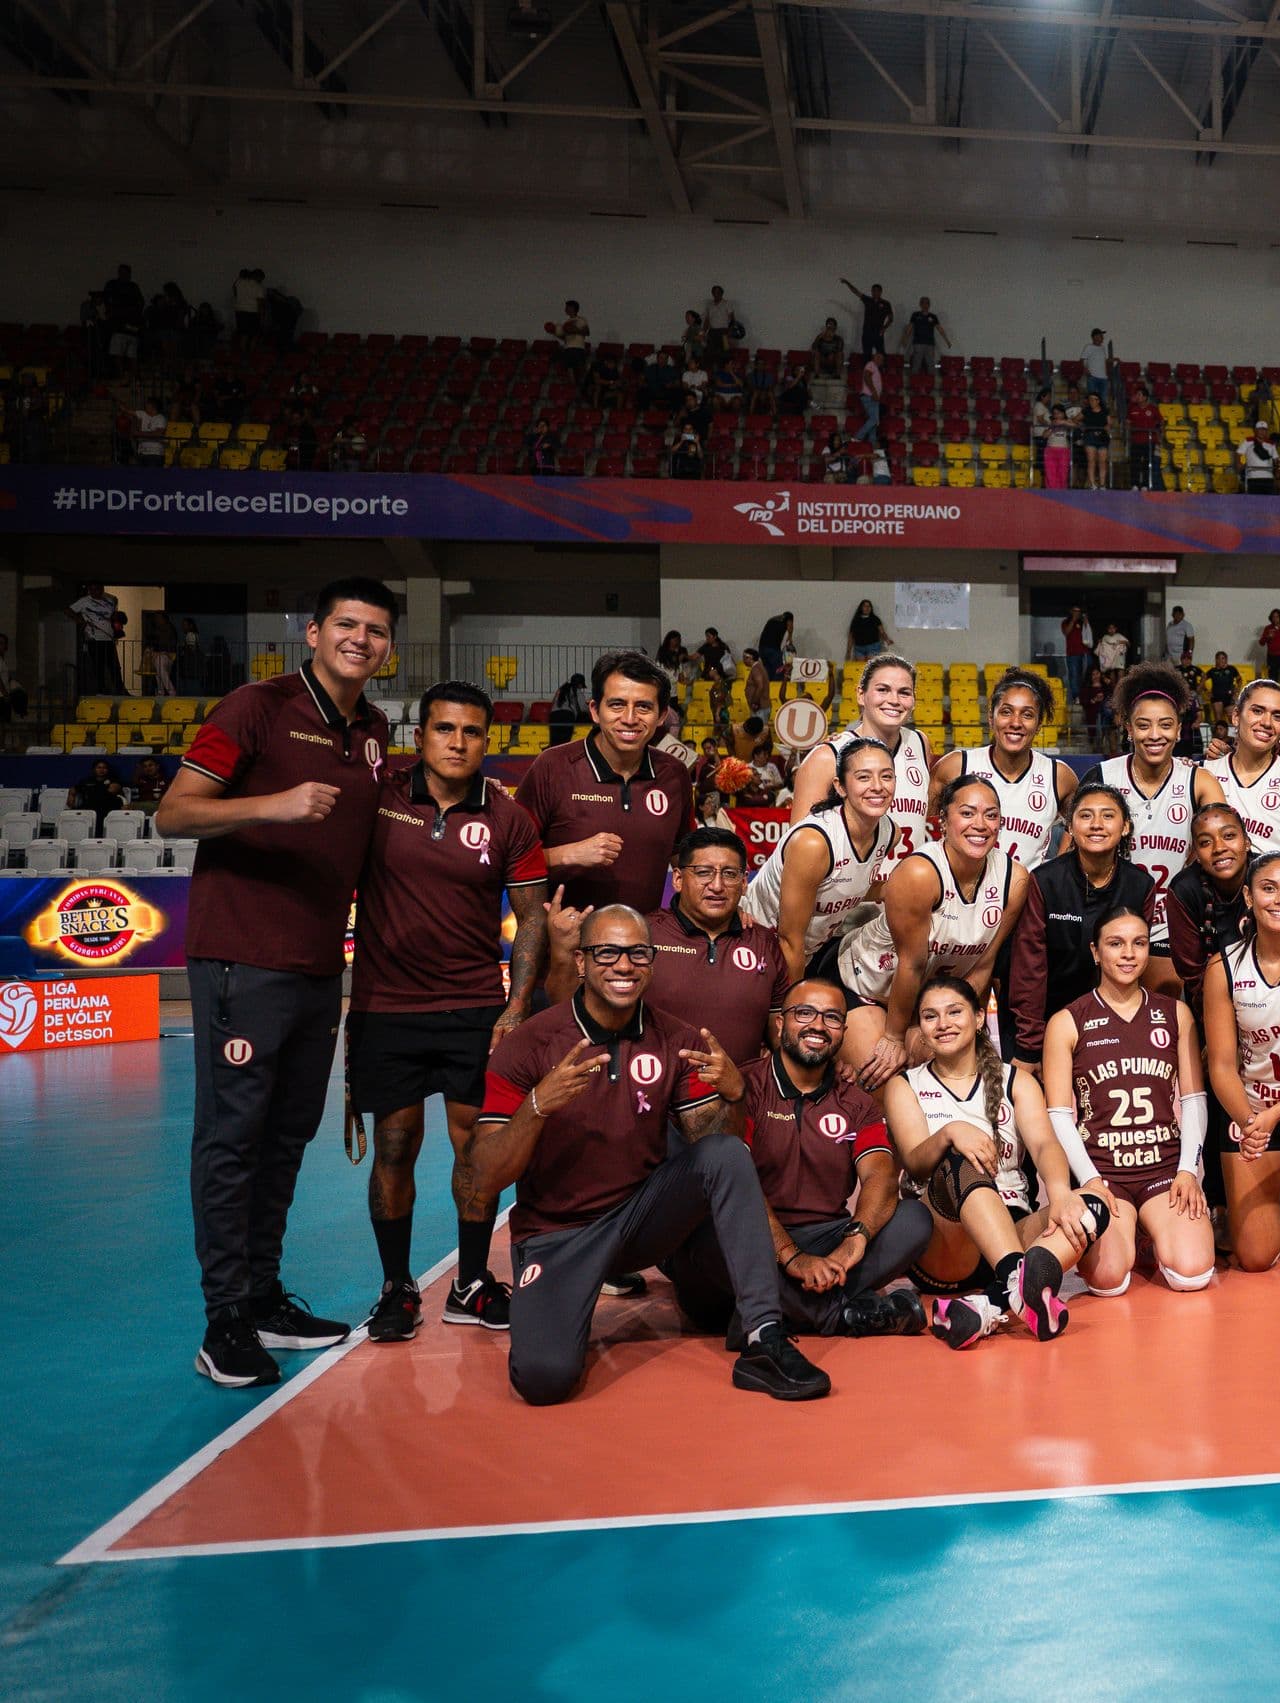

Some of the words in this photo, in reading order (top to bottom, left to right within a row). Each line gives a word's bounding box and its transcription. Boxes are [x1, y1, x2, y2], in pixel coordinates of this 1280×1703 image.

[53, 487, 409, 521] #IPDFortaleceElDeporte
[797, 502, 881, 518] INSTITUTO
[884, 504, 961, 520] PERUANO
[798, 519, 828, 533] DEL
[831, 520, 905, 535] DEPORTE
[786, 708, 818, 742] U
[289, 730, 333, 746] marathon
[571, 793, 613, 803] marathon
[377, 807, 425, 827] marathon
[1141, 835, 1187, 854] PUMAS
[1049, 912, 1083, 923] marathon
[44, 983, 77, 996] LIGA
[1234, 981, 1256, 989] MTD
[44, 995, 110, 1011] PERUANA
[1236, 1000, 1267, 1008] marathon
[44, 1014, 64, 1027] DE
[66, 1010, 112, 1025] VÓLEY
[1083, 1017, 1109, 1030] MTD
[44, 1027, 113, 1044] betsson
[1086, 1038, 1120, 1048] marathon
[1088, 1060, 1118, 1085] LAS
[1120, 1057, 1173, 1080] PUMAS
[1108, 1087, 1154, 1127] 25
[1097, 1124, 1171, 1151] apuesta
[1113, 1146, 1162, 1168] total
